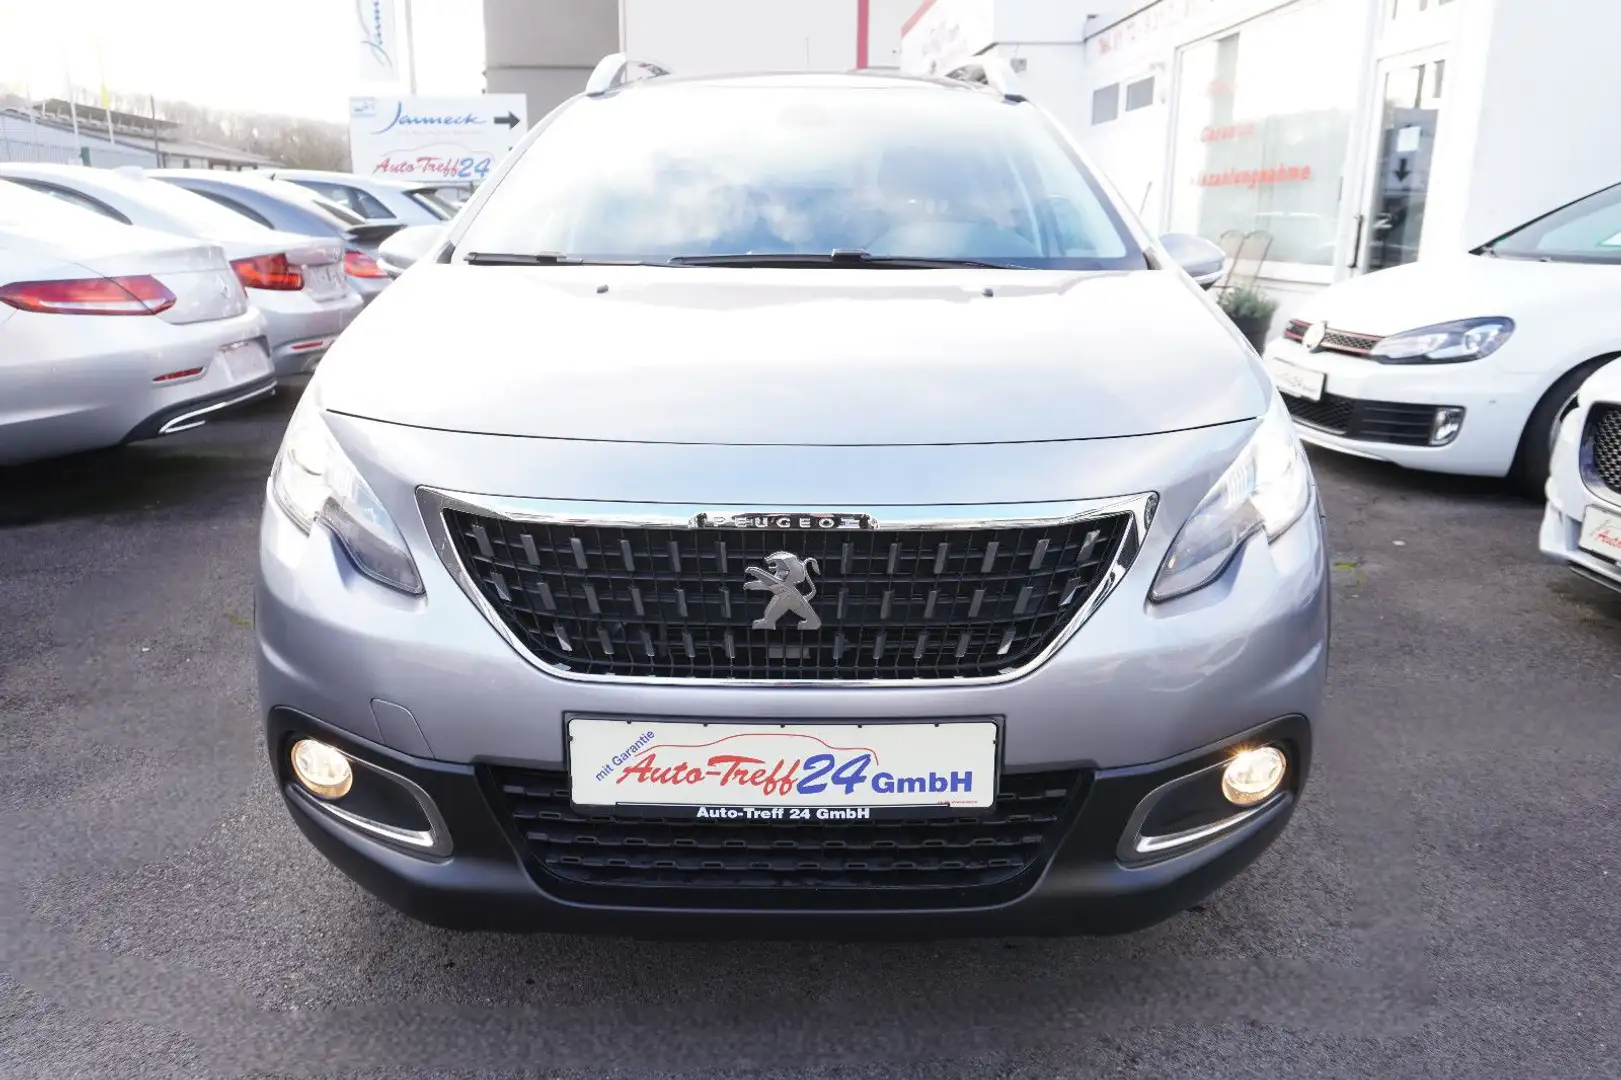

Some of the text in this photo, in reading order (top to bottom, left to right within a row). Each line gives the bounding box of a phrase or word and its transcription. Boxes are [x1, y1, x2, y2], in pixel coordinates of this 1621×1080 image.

[595, 730, 655, 782] mit Garantie
[871, 771, 973, 793] GmbH
[696, 806, 870, 820] Auto-Treff 24 GmbH
